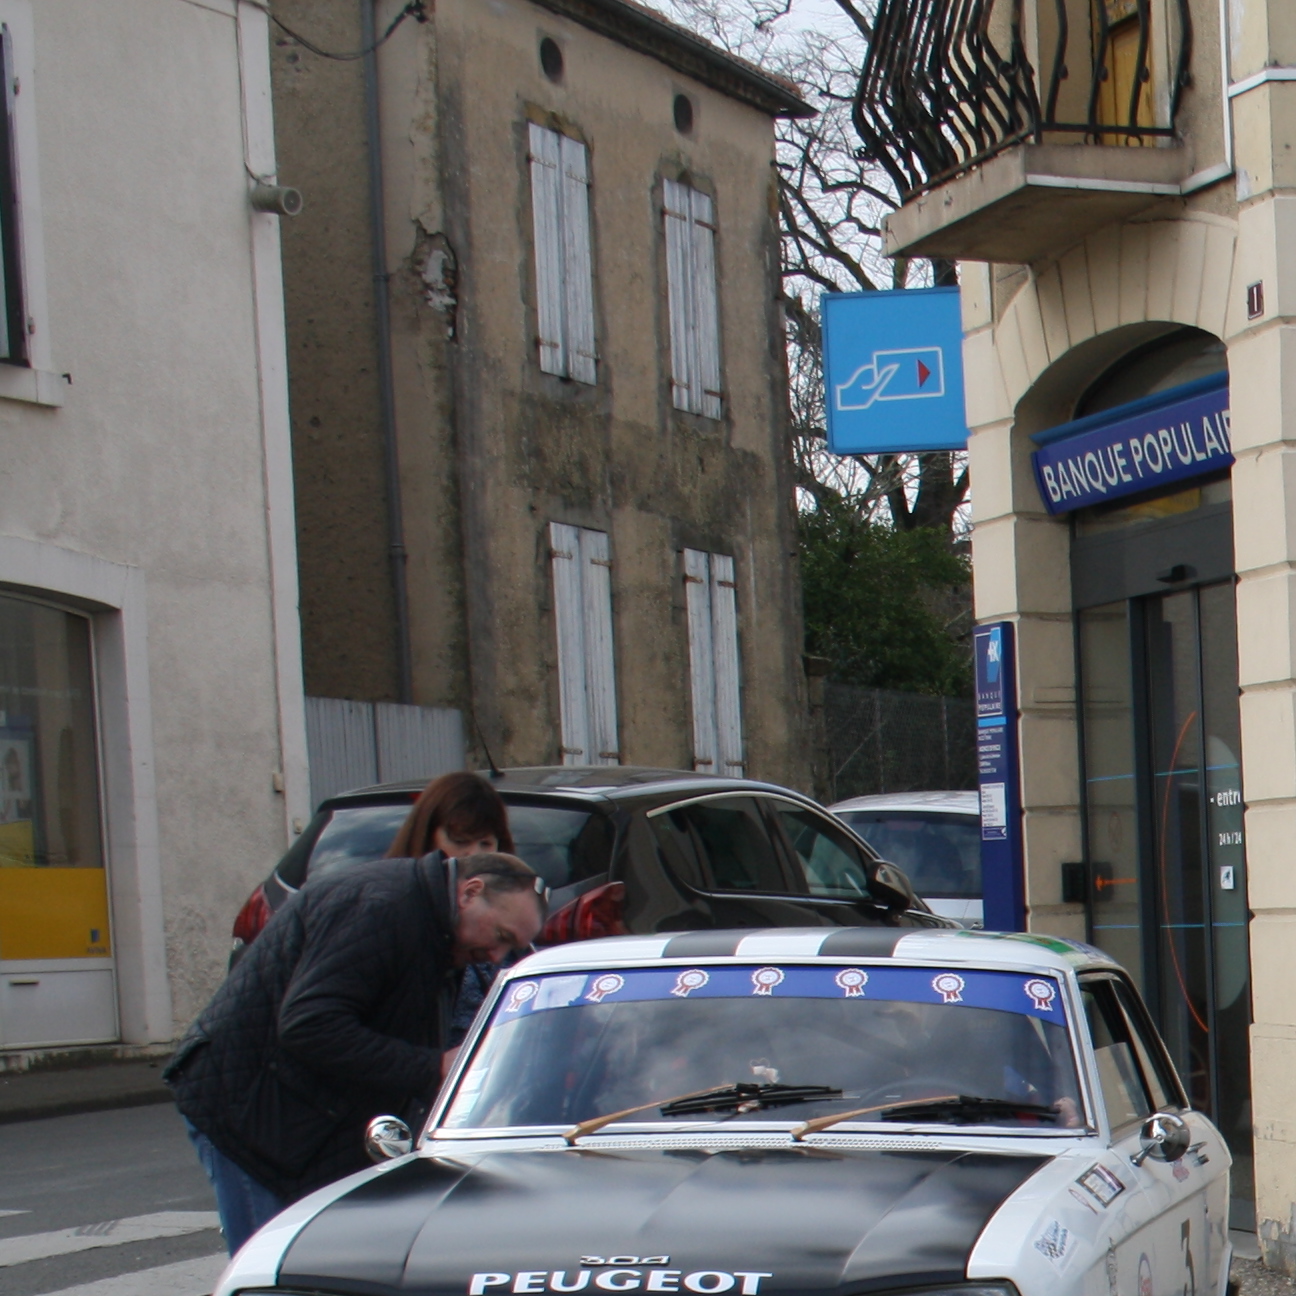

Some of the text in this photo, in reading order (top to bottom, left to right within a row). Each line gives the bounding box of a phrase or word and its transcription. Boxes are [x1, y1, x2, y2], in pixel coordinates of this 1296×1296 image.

[1043, 409, 1231, 503] BANQUE POPULAIR
[580, 1255, 671, 1266] 304
[469, 1269, 774, 1296] PEUGEOT
